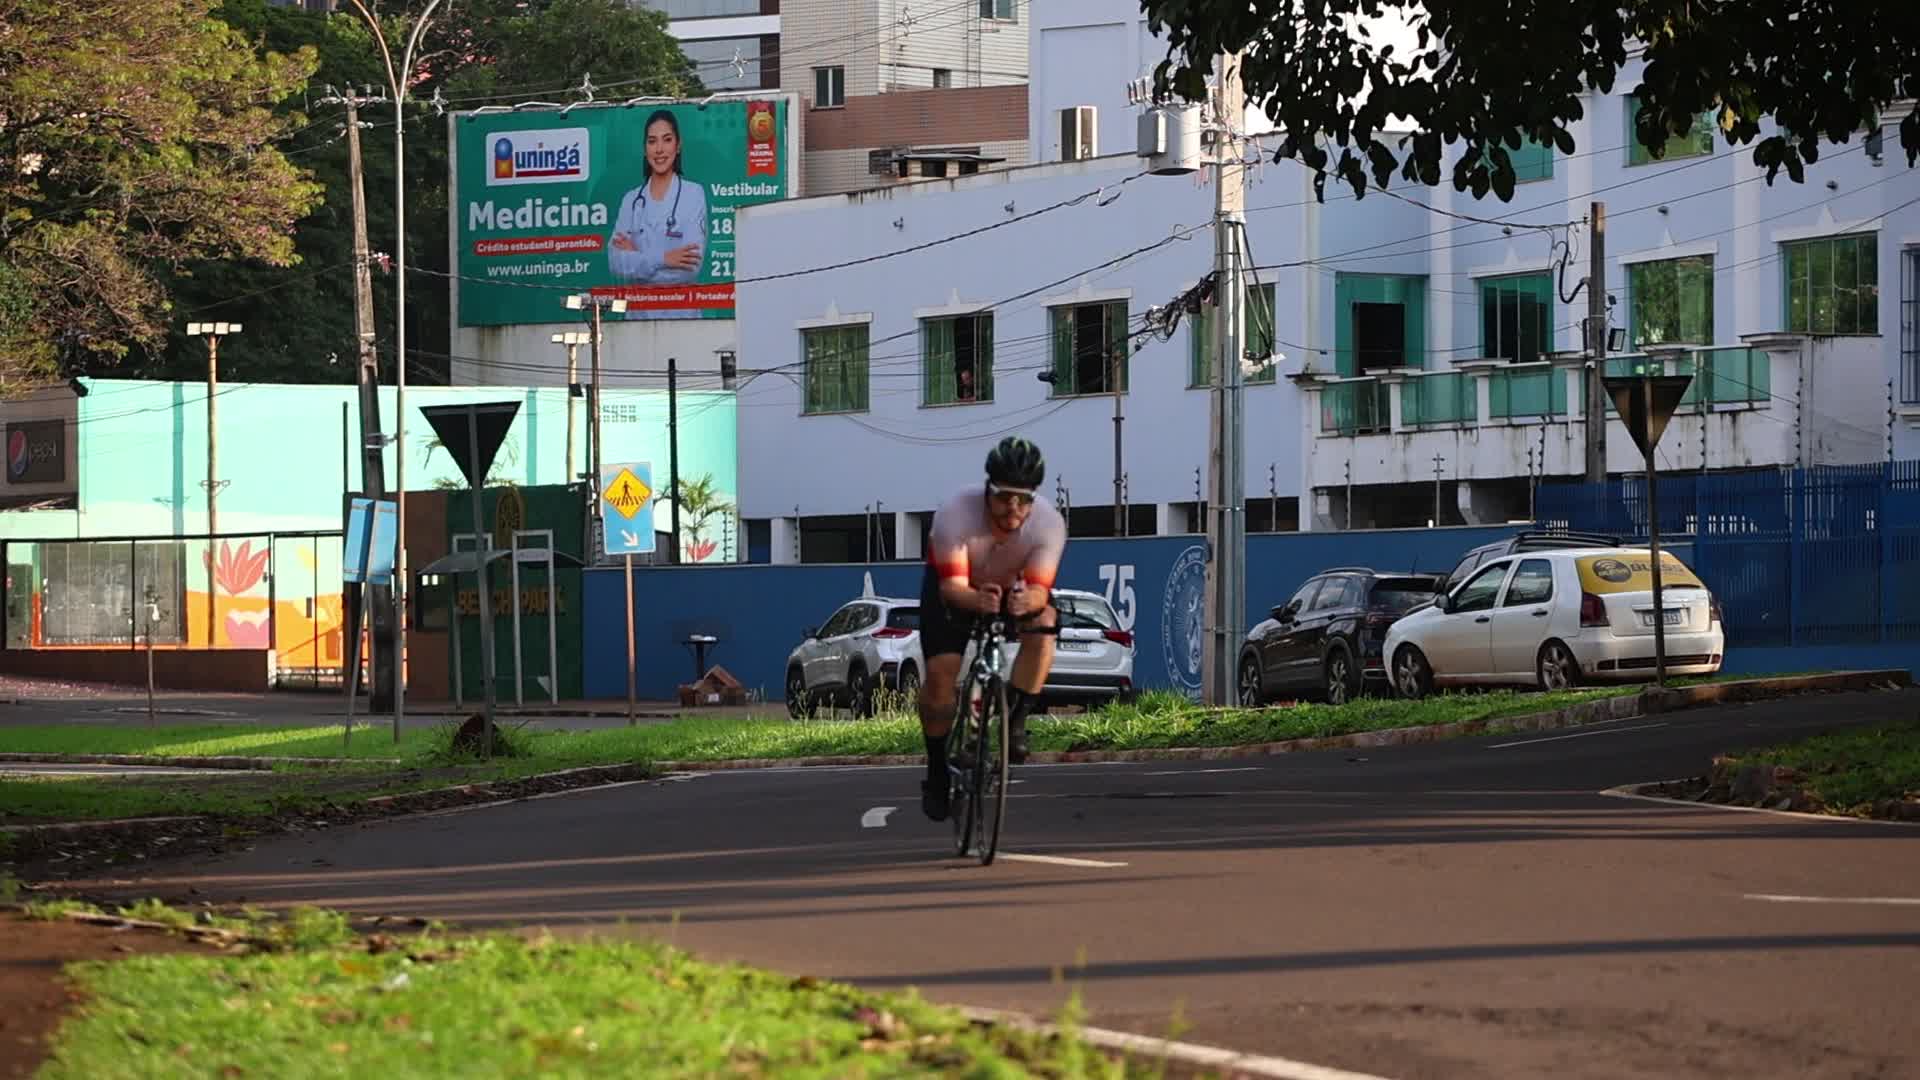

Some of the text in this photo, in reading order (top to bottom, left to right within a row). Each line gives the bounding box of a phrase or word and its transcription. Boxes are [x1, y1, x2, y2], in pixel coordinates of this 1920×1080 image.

[515, 142, 580, 172] uningá
[711, 183, 779, 197] Vestibular
[469, 197, 608, 231] Medicina
[477, 238, 600, 253] Crédito estudantil garantido.
[487, 259, 590, 278] www.uninga.br
[1099, 564, 1136, 632] 75
